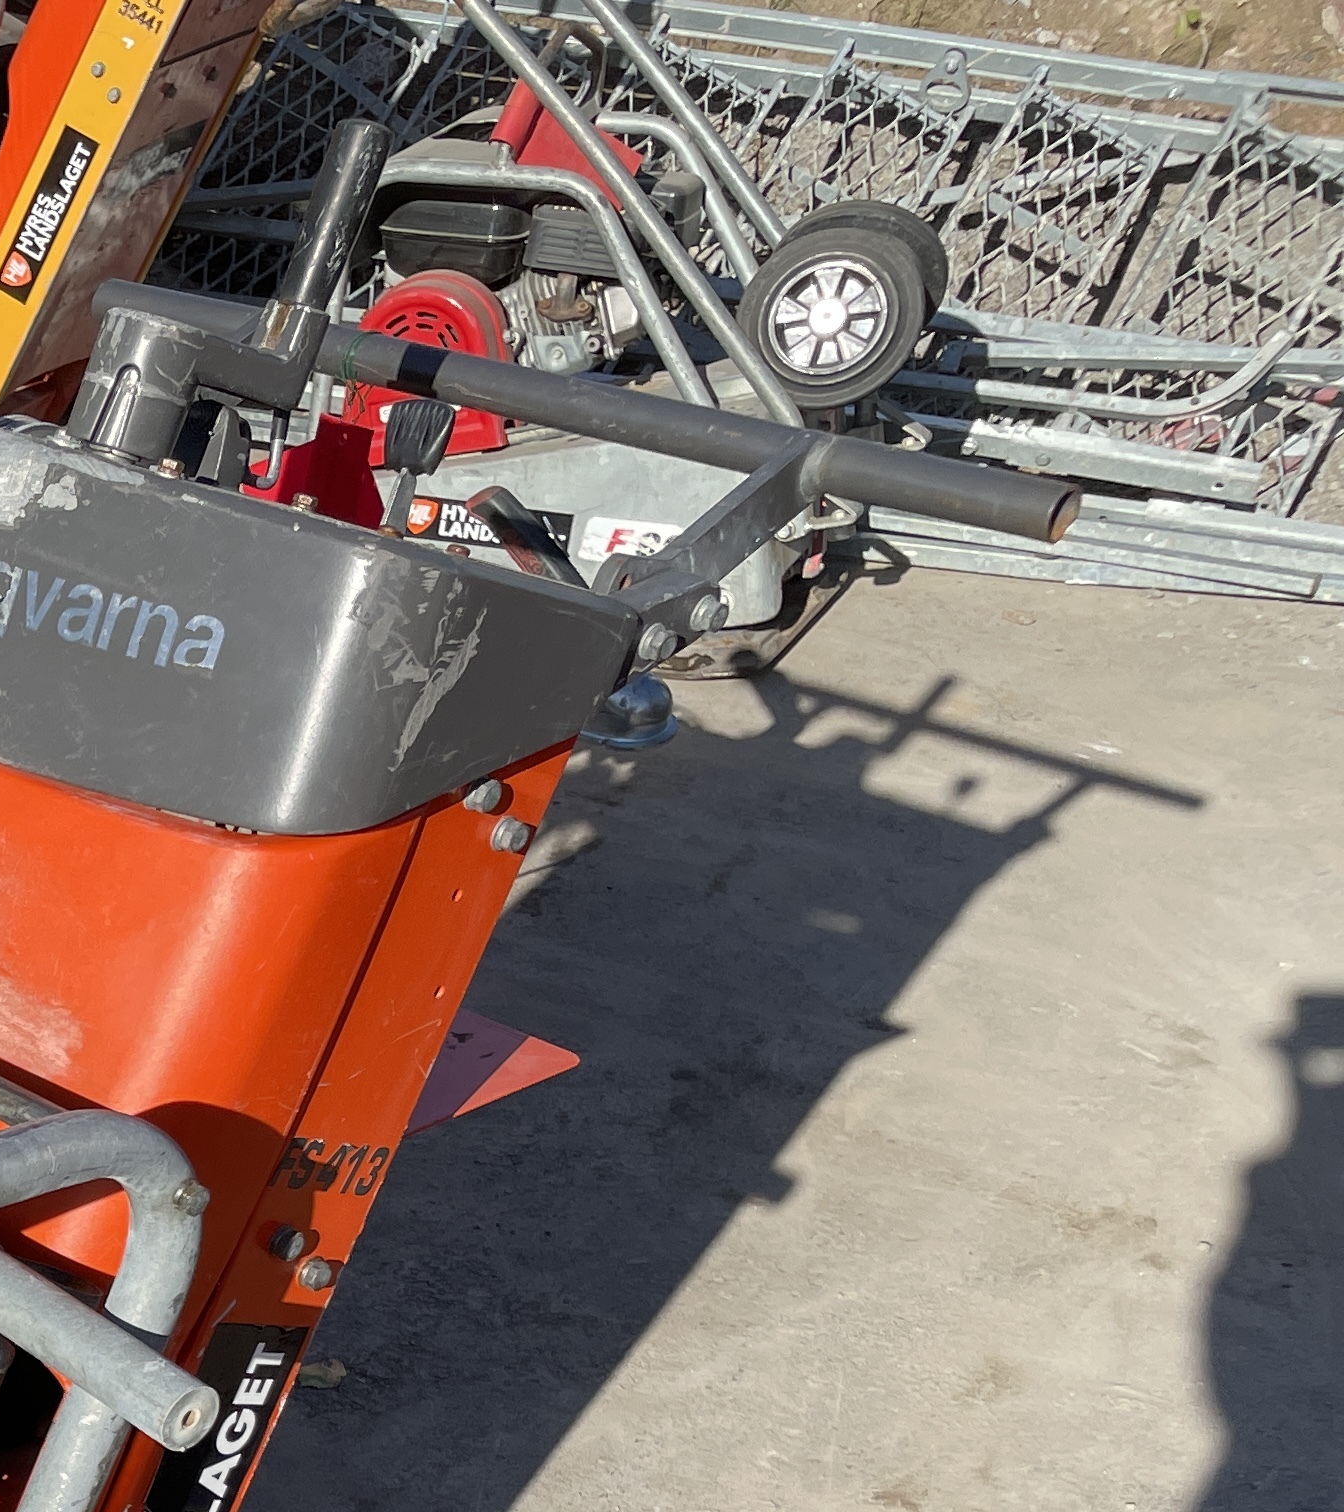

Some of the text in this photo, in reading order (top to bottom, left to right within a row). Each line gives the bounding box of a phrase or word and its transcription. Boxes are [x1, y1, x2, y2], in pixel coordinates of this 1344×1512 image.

[118, 0, 164, 35] 35441
[15, 193, 52, 252] HYRES
[25, 141, 91, 262] LANDSLAGET
